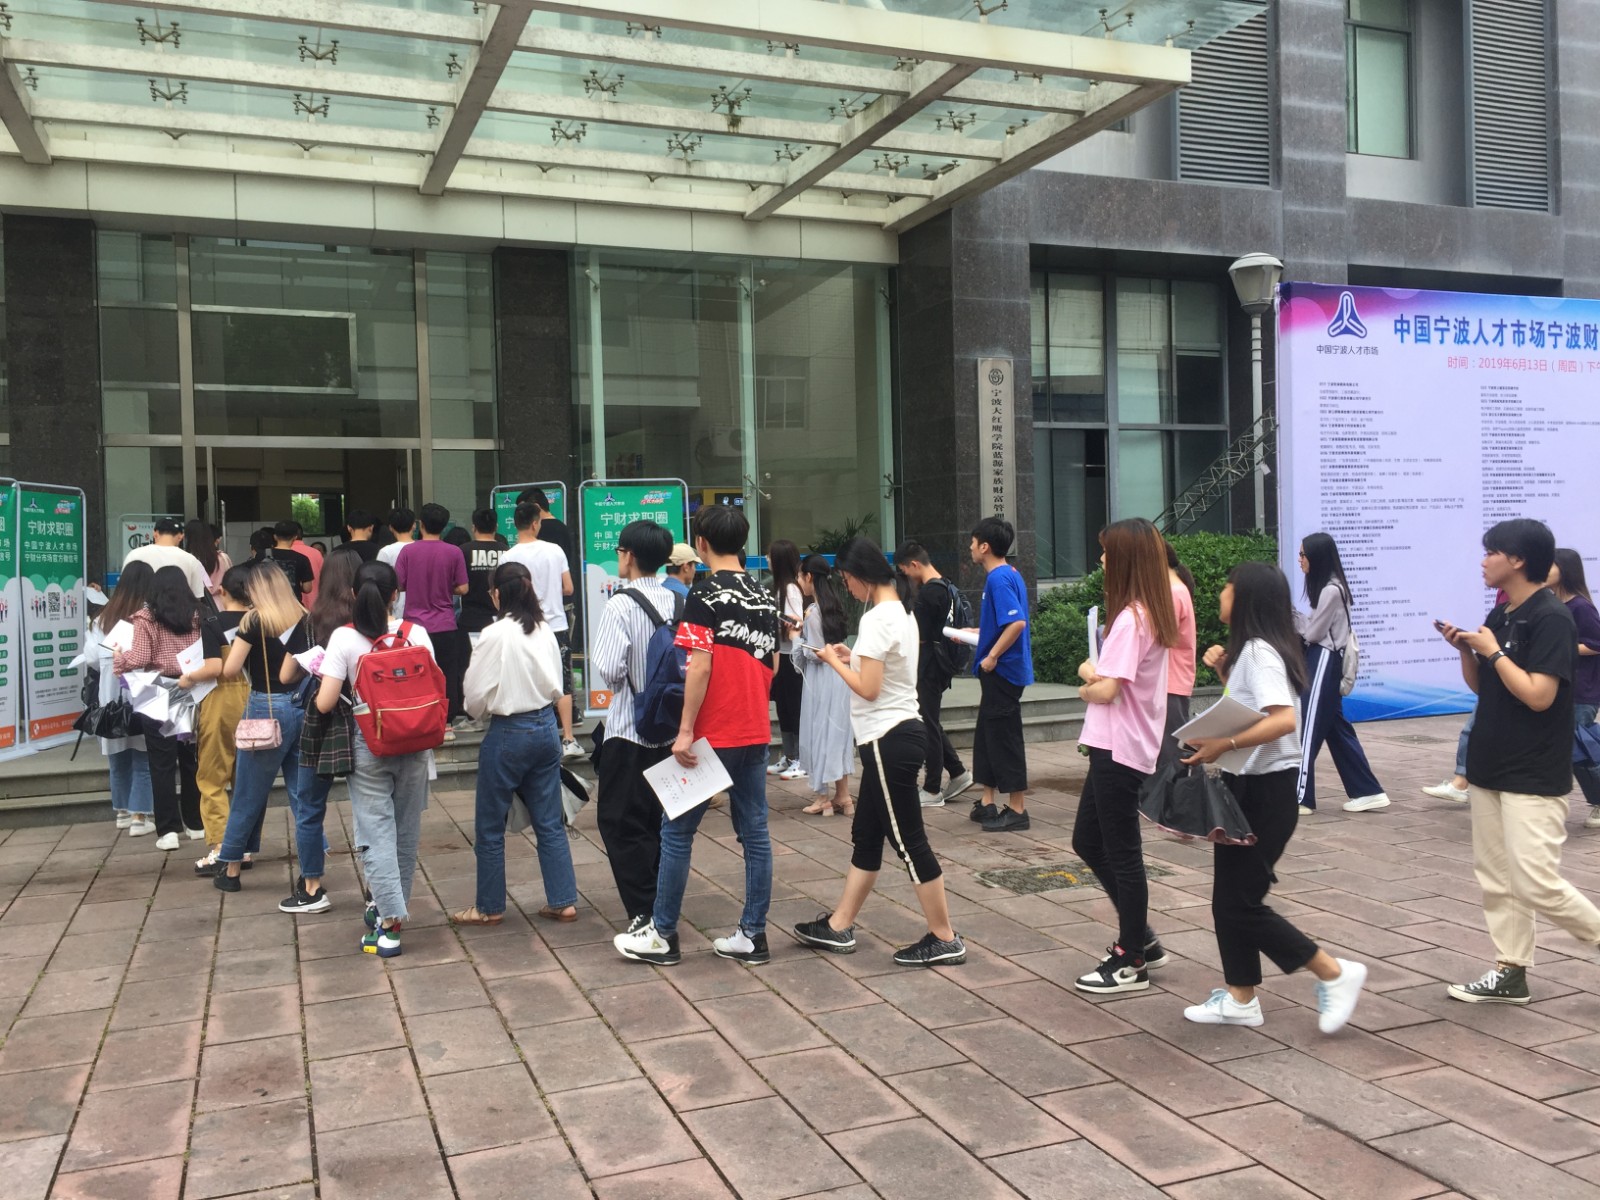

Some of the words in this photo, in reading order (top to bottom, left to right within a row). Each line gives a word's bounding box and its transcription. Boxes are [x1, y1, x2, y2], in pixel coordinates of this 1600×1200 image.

[1394, 313, 1599, 351] 中国宁波人才市场宁波财
[1316, 344, 1379, 356] 中国宁波人才市场
[28, 520, 74, 537] 宁财求职圈
[24, 541, 78, 551] 中国宁波人才市场
